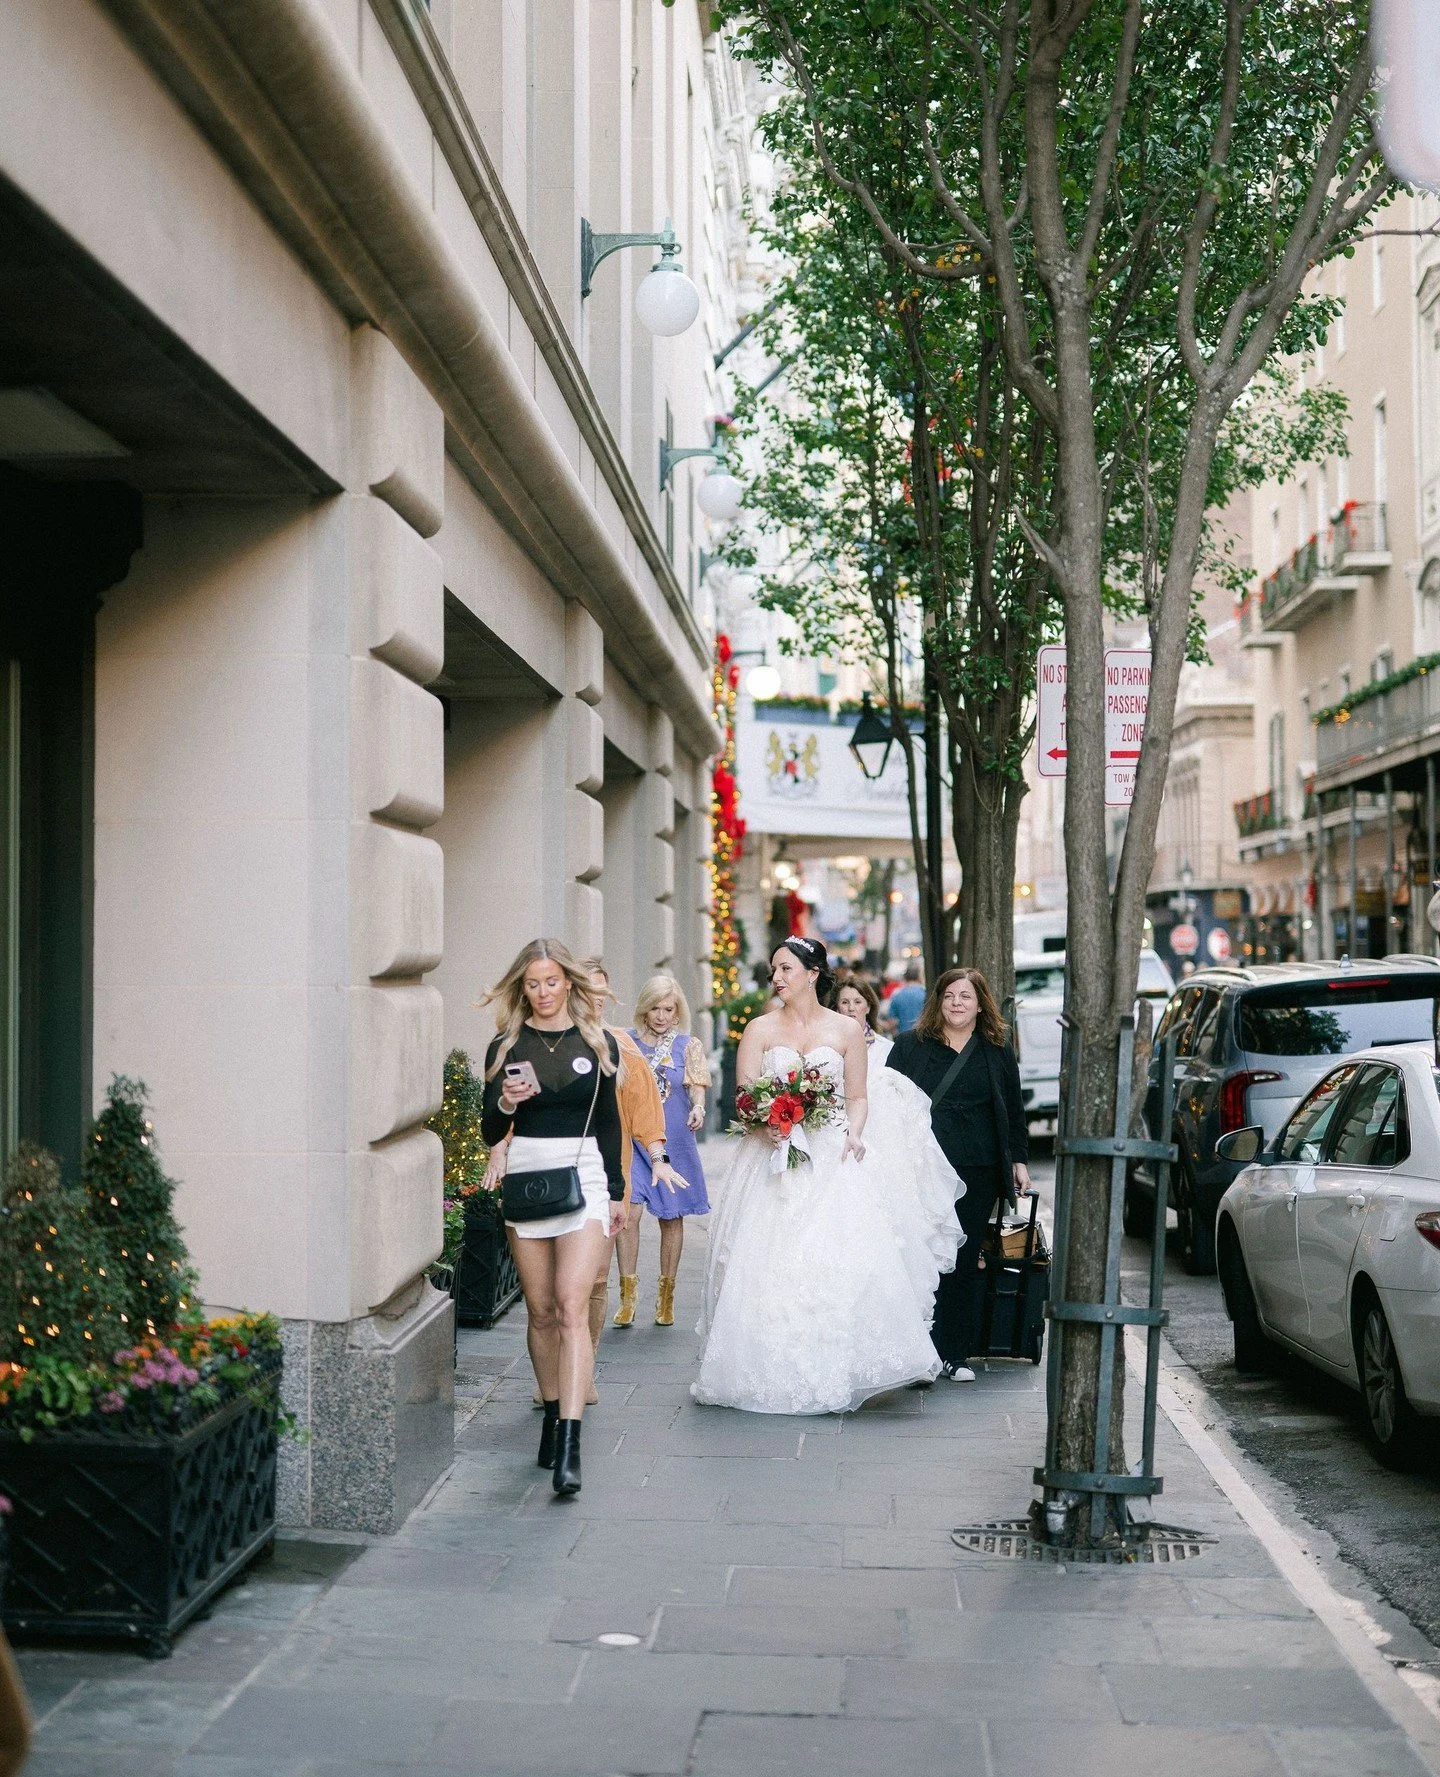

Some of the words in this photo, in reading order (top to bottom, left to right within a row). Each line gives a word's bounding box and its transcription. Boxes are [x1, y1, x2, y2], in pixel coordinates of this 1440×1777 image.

[1043, 664, 1054, 683] NO
[1107, 667, 1119, 686] NO
[1121, 667, 1151, 686] PARKIN
[1107, 695, 1147, 714] PASSENG
[1114, 773, 1130, 783] TOW
[1123, 787, 1134, 797] ZO
